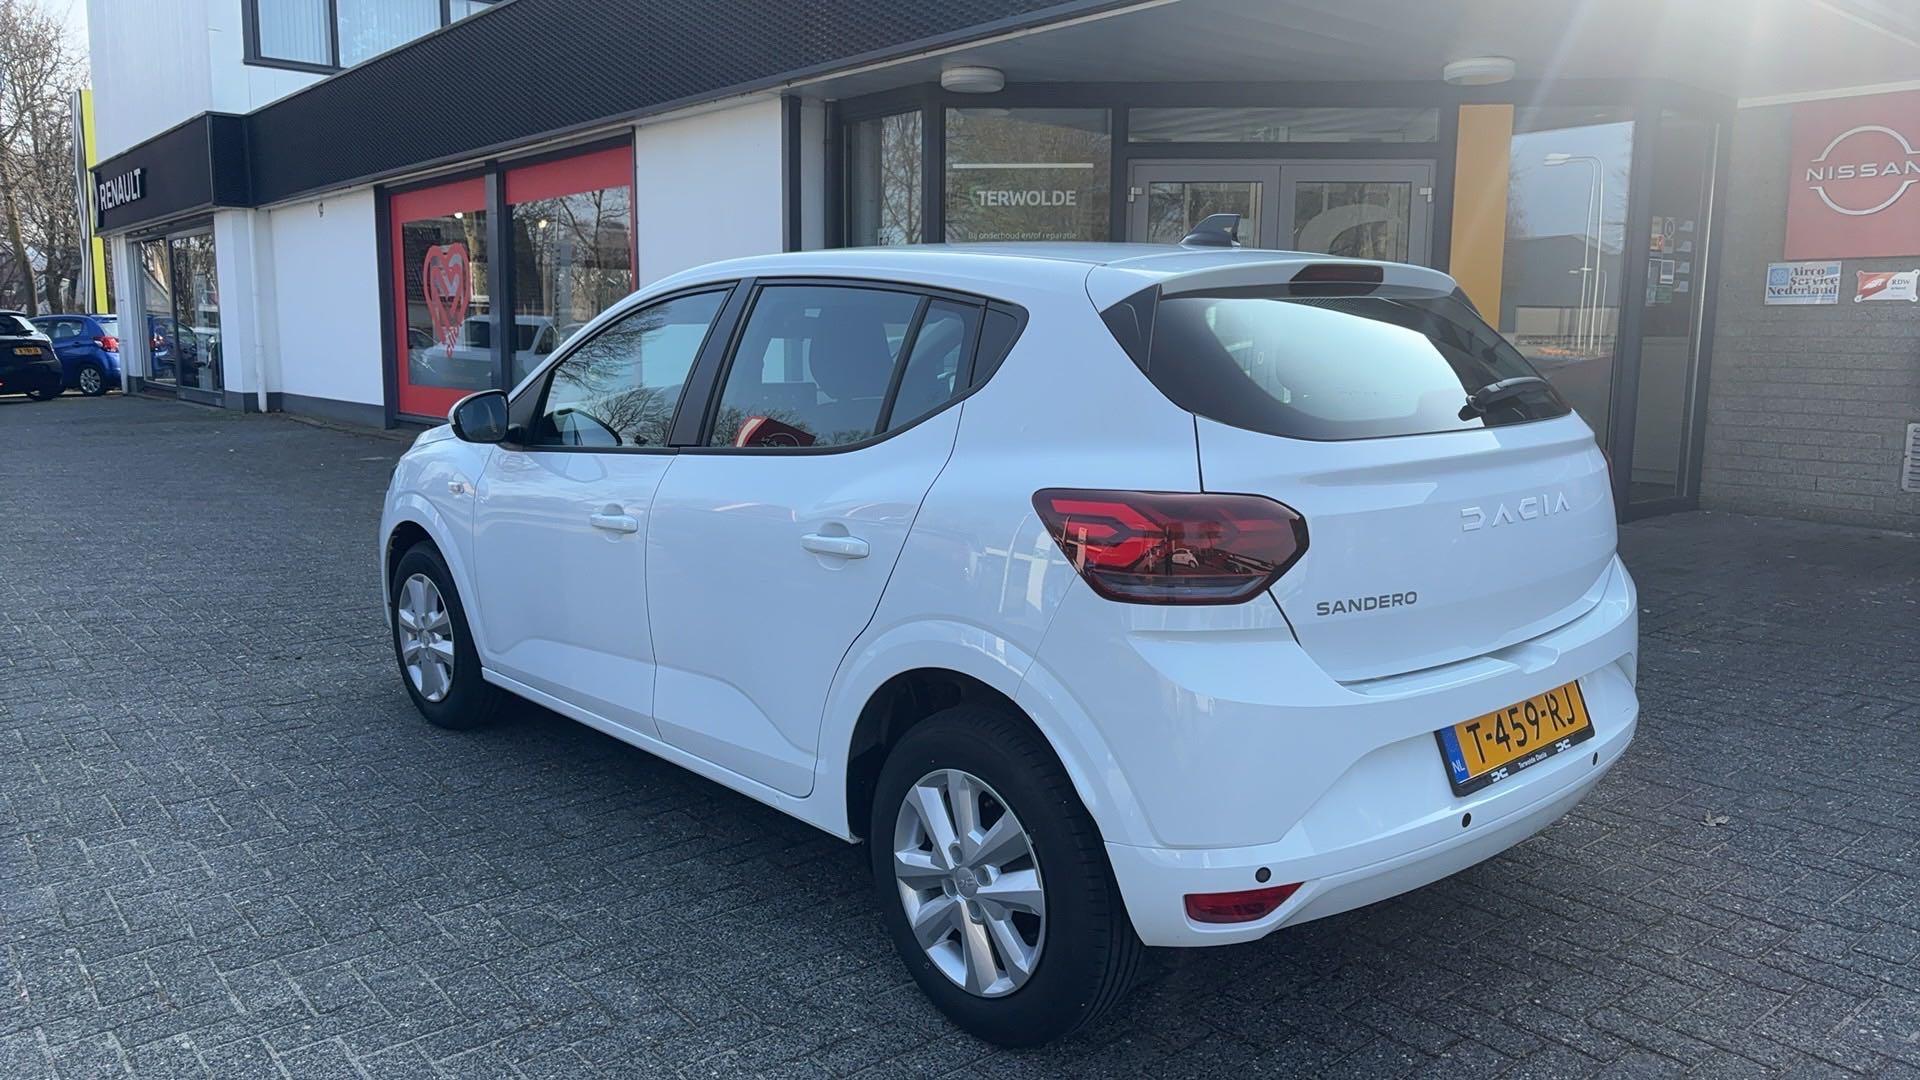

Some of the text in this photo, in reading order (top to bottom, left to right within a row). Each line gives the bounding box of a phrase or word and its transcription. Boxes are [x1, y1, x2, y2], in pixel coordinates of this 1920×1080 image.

[1806, 160, 1920, 181] NISSAN
[99, 168, 141, 211] RENAULT
[976, 190, 1077, 206] TERWOLDE
[979, 231, 1020, 240] onderhoud
[1790, 266, 1825, 277] Airco
[1790, 276, 1838, 286] Service
[1768, 285, 1837, 296] Nederland
[1460, 492, 1570, 532] DACIA
[1316, 591, 1418, 616] SANDERO
[1465, 687, 1576, 764] T-459-RJ
[1452, 759, 1466, 774] NL
